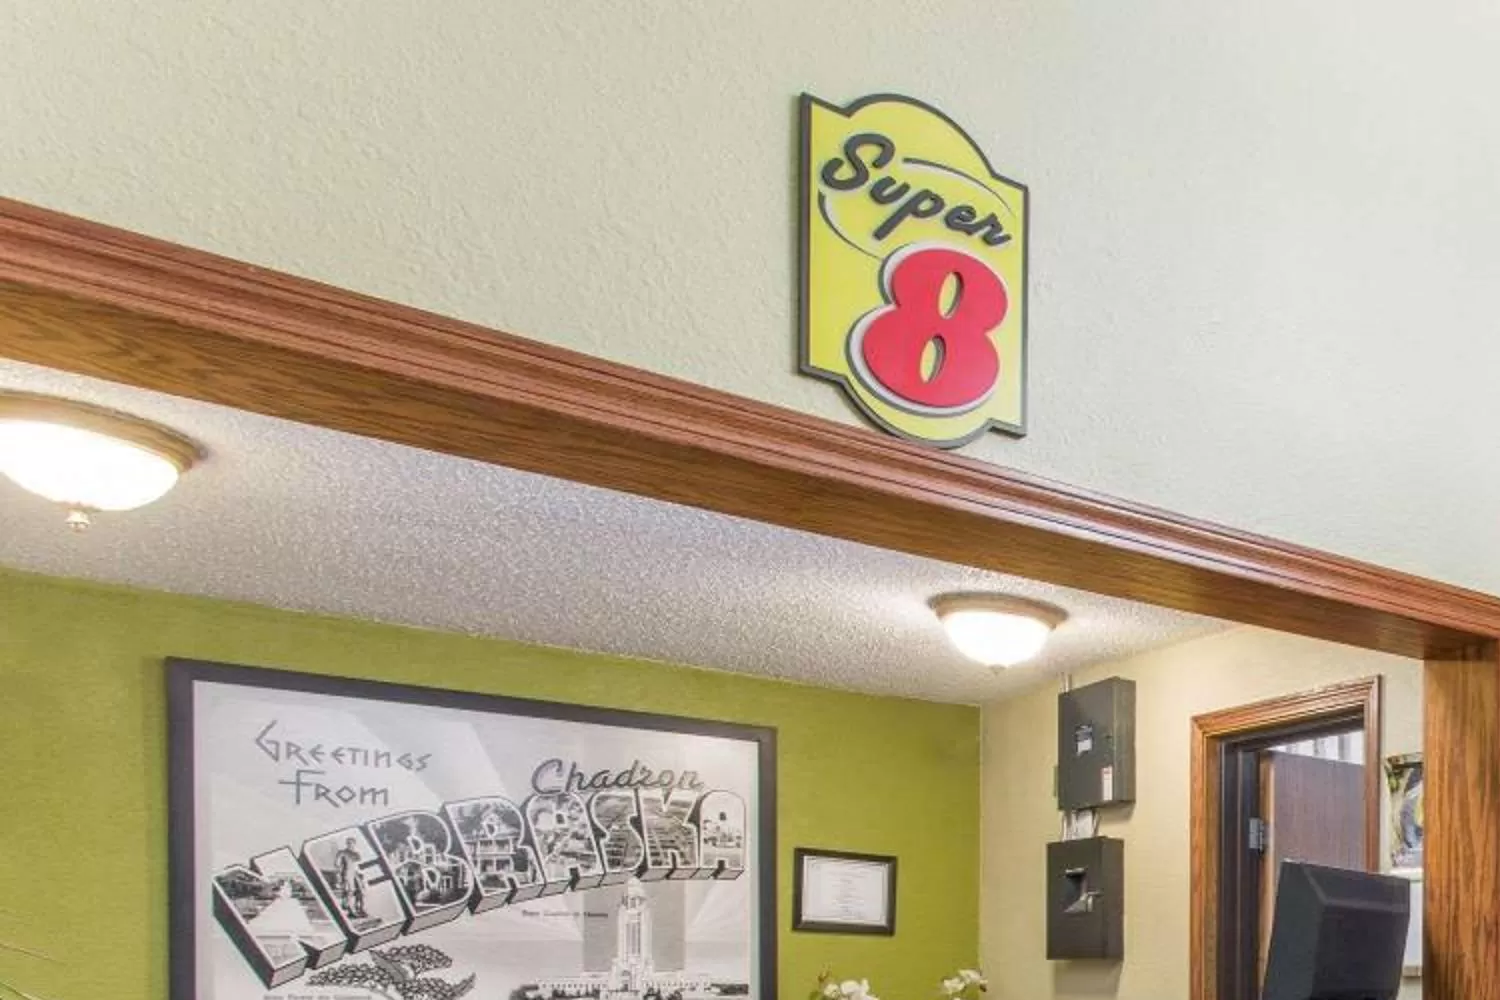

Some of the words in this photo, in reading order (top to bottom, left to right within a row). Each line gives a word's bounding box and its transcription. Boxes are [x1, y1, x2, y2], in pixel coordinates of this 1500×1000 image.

[821, 133, 1012, 247] Super
[850, 245, 1009, 415] 8
[531, 757, 708, 795] Chadron
[212, 788, 746, 990] NEBRASKA
